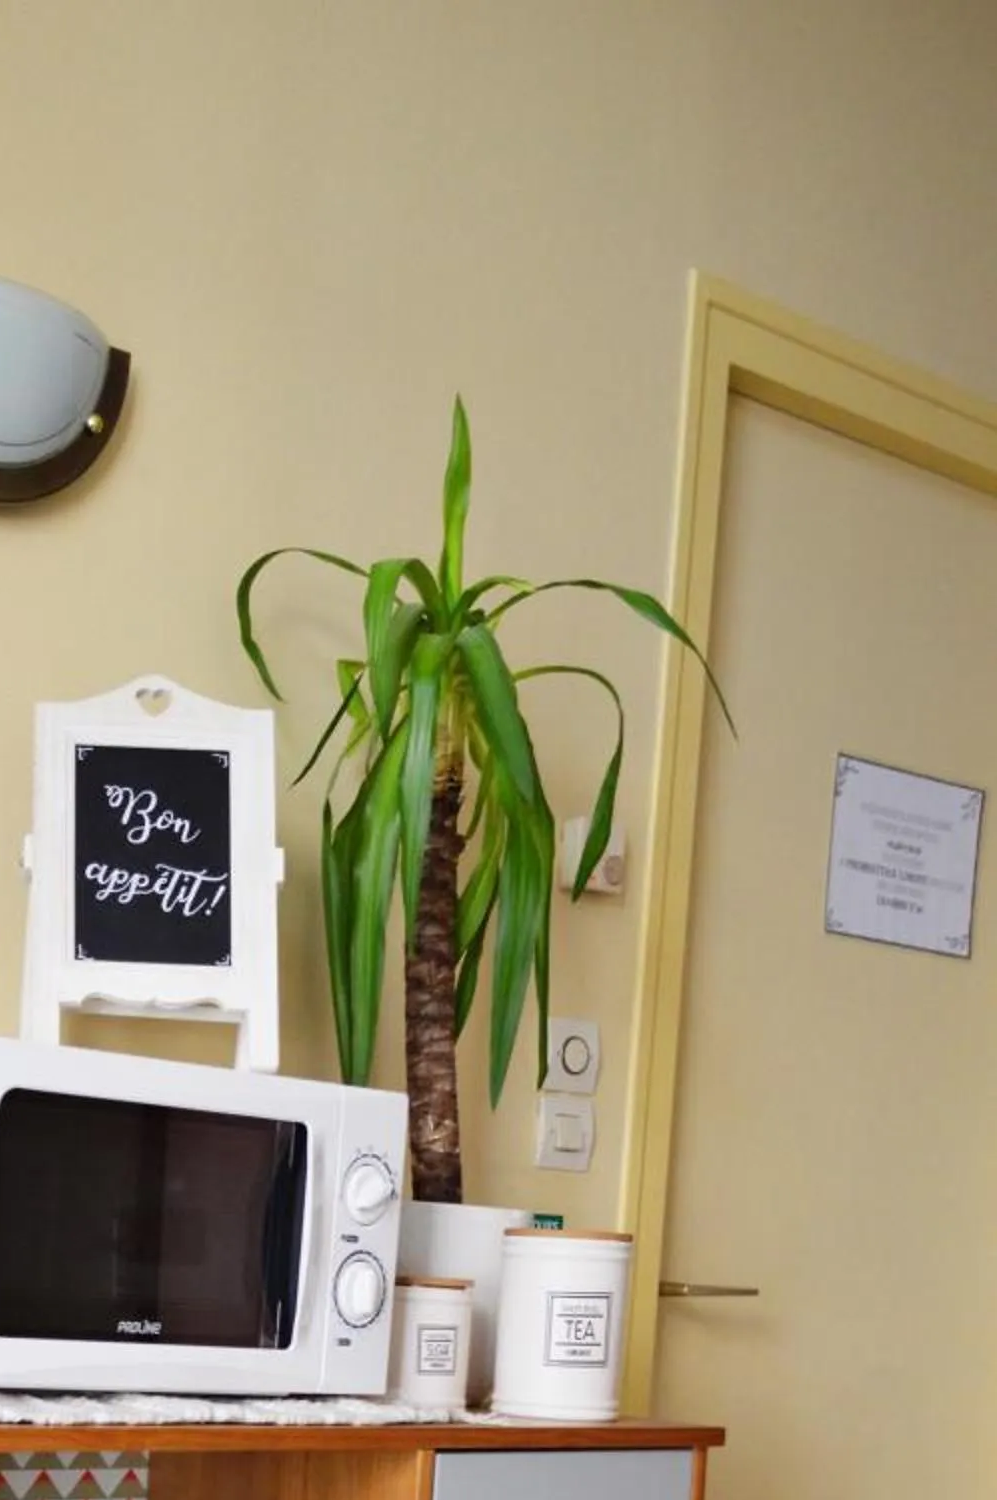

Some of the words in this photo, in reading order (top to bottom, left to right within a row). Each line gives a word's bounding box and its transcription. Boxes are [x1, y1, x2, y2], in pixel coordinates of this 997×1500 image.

[103, 784, 201, 844] Bon
[84, 862, 228, 917] appétit!
[563, 1319, 596, 1341] TEA
